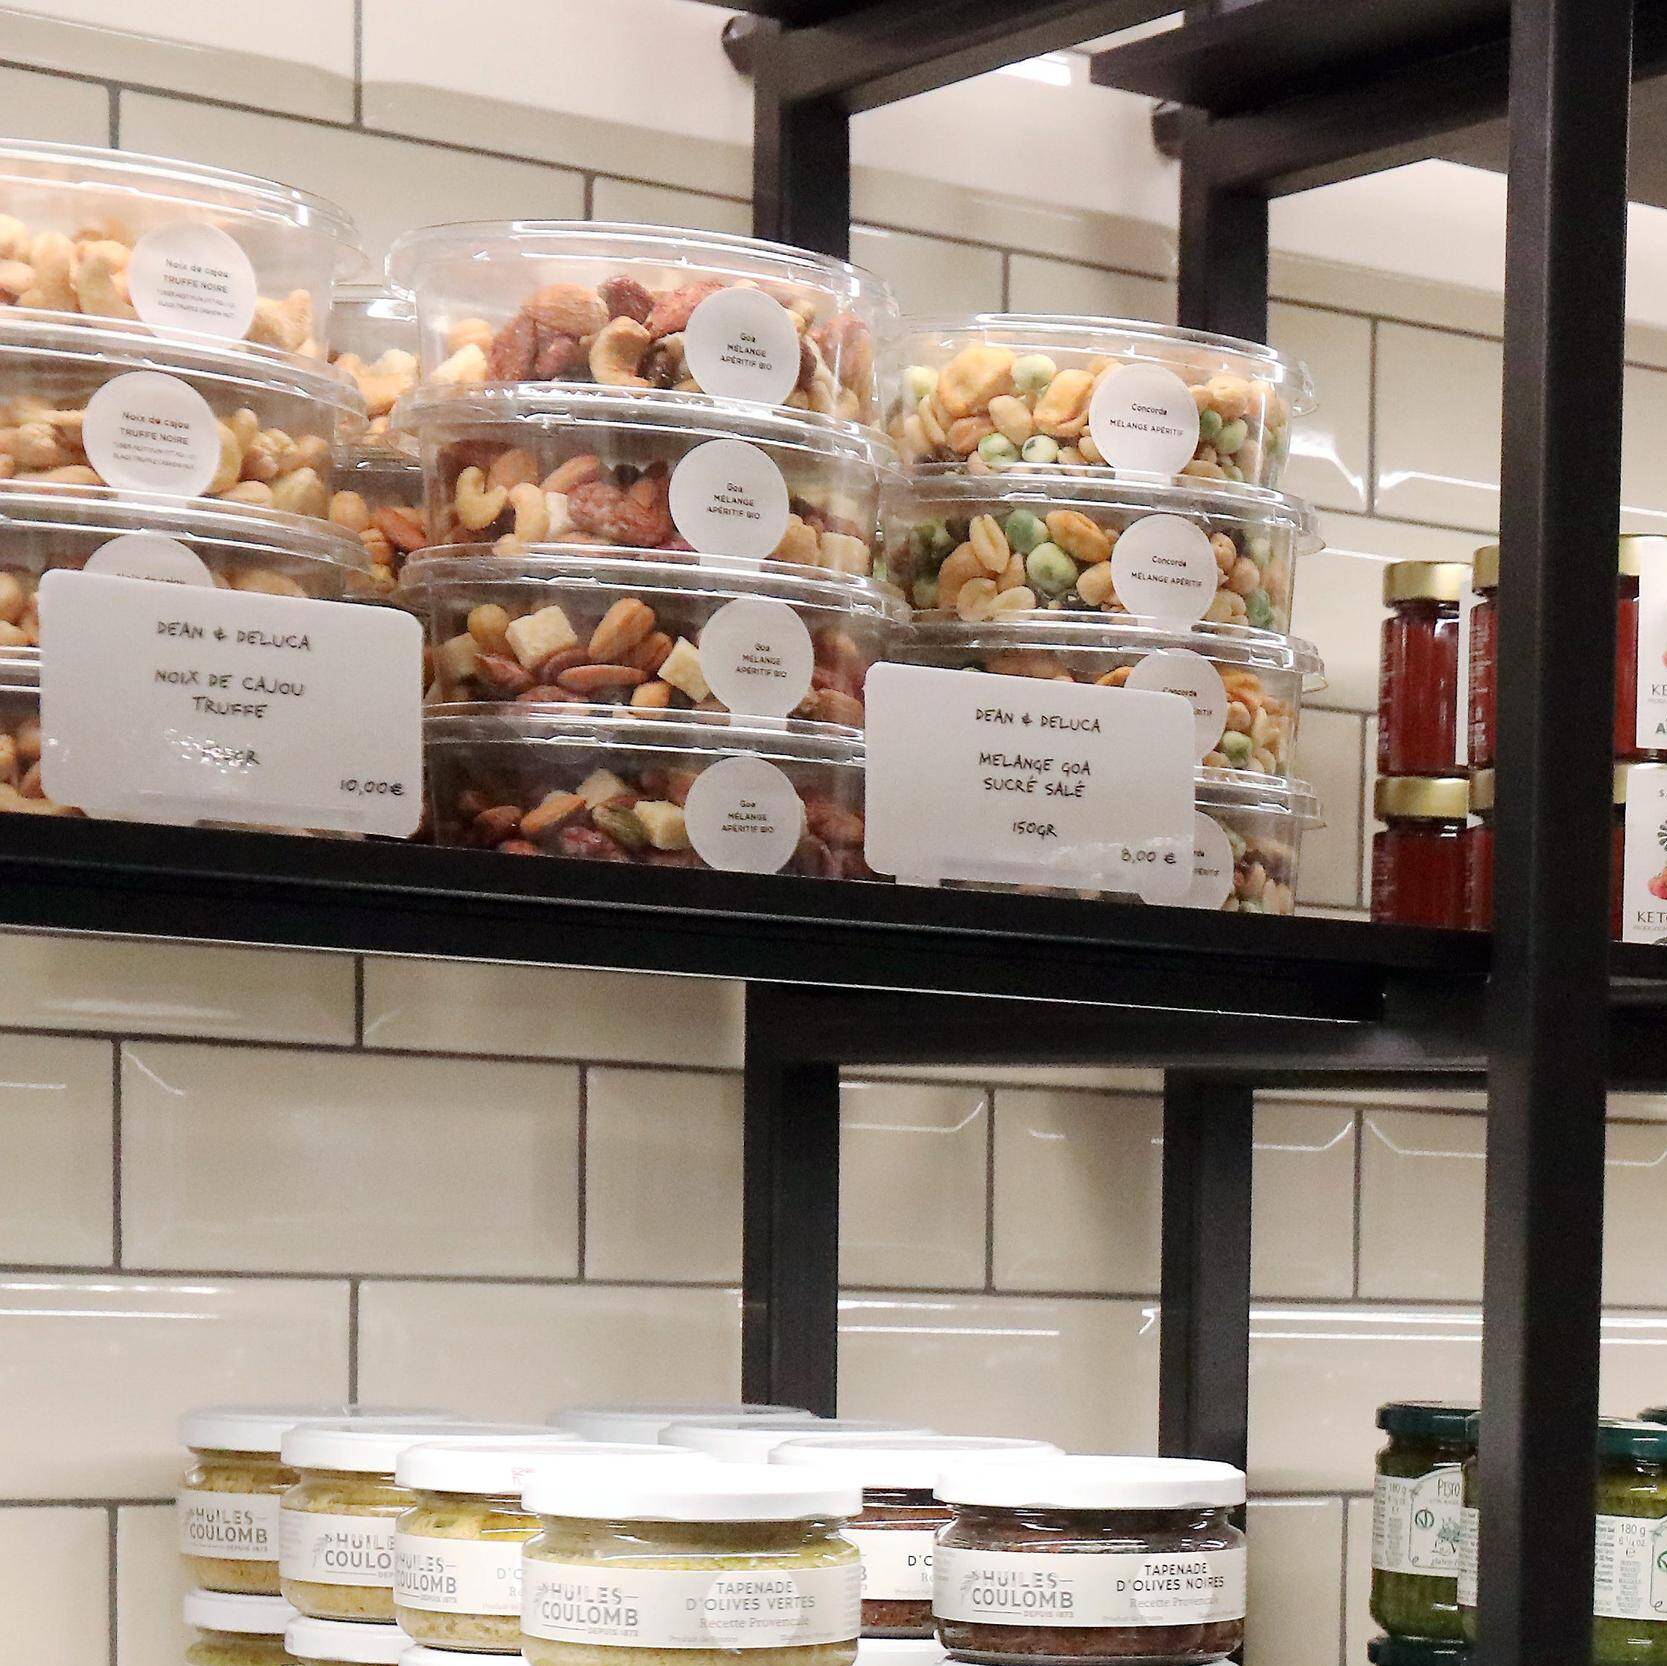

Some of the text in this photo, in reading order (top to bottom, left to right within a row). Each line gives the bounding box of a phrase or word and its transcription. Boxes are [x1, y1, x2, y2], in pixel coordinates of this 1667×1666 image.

[1131, 402, 1168, 417] Concorde
[1151, 555, 1187, 568] Concorde
[157, 621, 203, 640] DEAN
[237, 629, 312, 651] DELUCA
[155, 668, 305, 696] NOIX DE CAJOU
[193, 696, 268, 718] TRUFFE
[976, 708, 1014, 724] DEAN
[1040, 714, 1100, 733] DELUCA
[978, 752, 1091, 776] MELANGE GOA
[984, 776, 1086, 798] SUCRÉ SALÉ
[1012, 821, 1058, 840] 150GR
[189, 1523, 268, 1544] COULOMB
[1620, 1524, 1638, 1536] 180
[985, 1570, 1057, 1587] HUILES
[1145, 1562, 1207, 1576] TAPENADE
[551, 1583, 622, 1605] HUILES
[717, 1581, 793, 1595] TAPENADE
[1116, 1575, 1224, 1593] D'OLIVES NOIRES
[686, 1596, 815, 1612] D'OLIVES VERTES
[972, 1588, 1074, 1608] COULOMB
[542, 1601, 638, 1627] COULOMB
